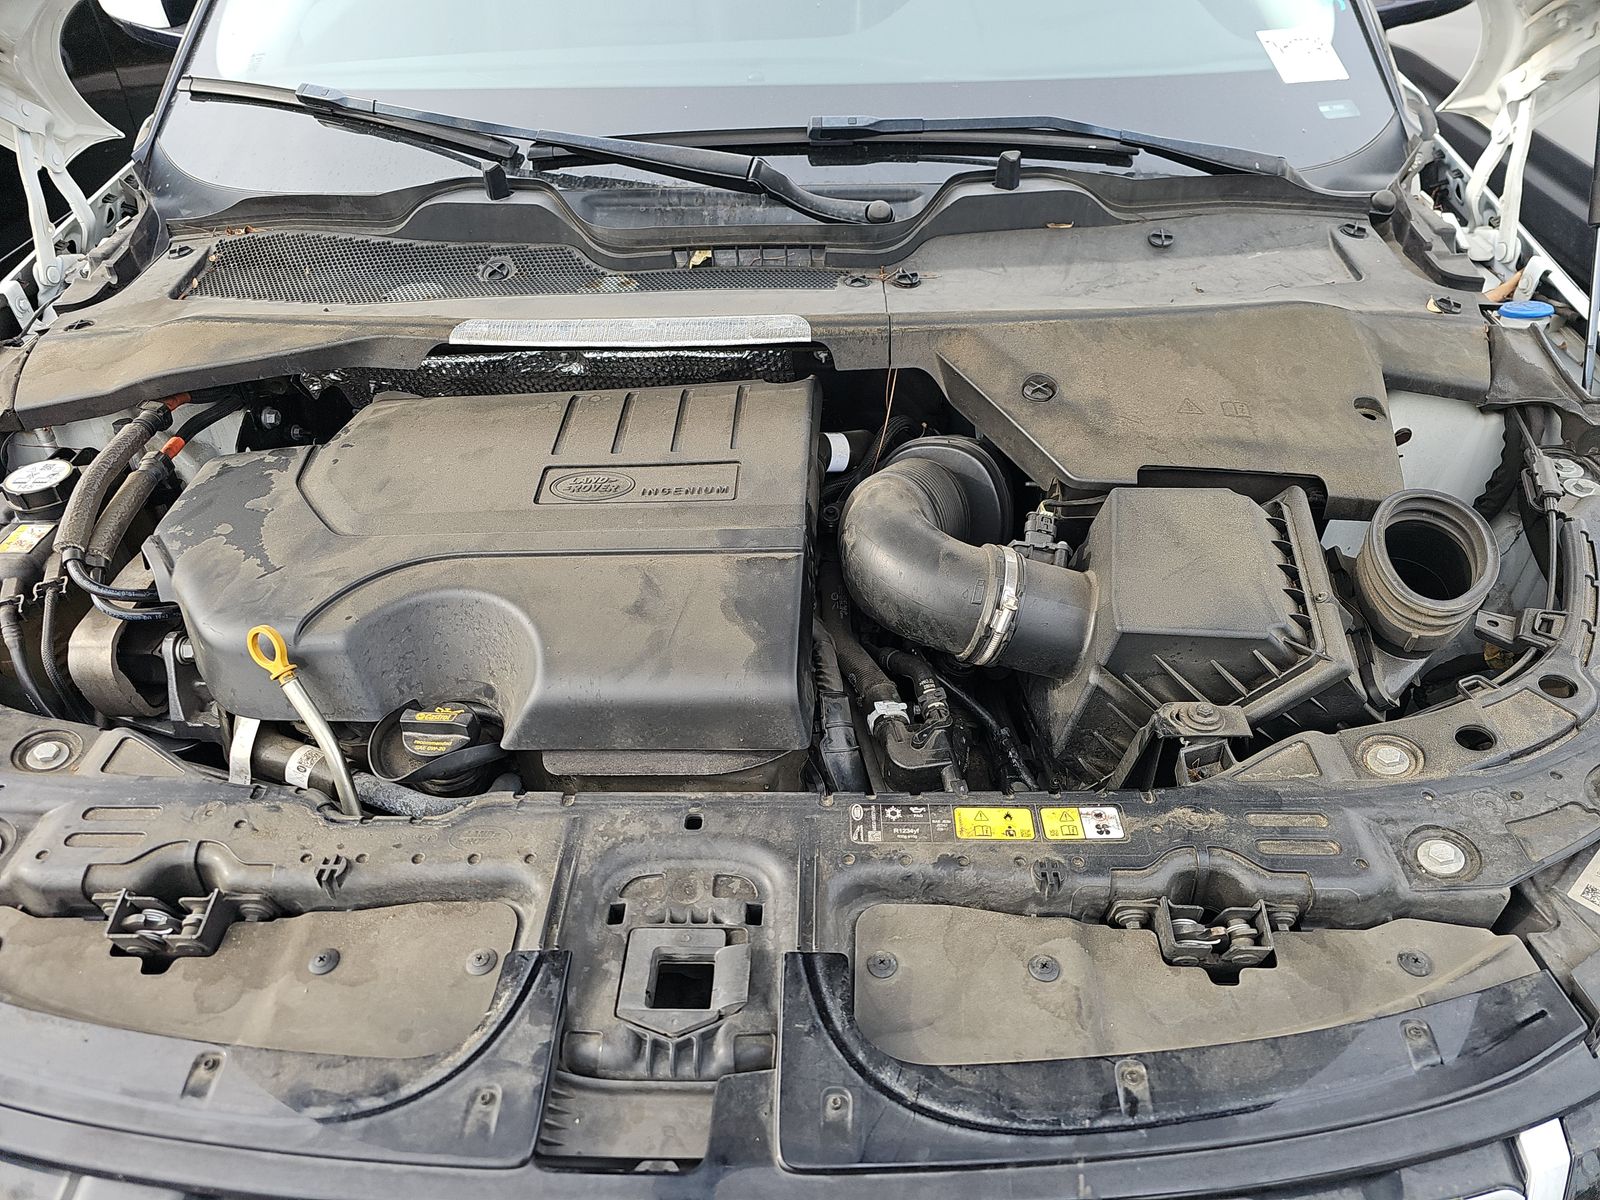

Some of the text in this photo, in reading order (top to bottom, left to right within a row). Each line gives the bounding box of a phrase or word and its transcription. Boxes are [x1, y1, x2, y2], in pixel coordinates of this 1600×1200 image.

[570, 476, 611, 485] LAND
[570, 484, 620, 493] ROVER
[641, 485, 730, 497] INGENIUM
[424, 713, 452, 721] Castrol
[893, 827, 920, 835] R1234yf
